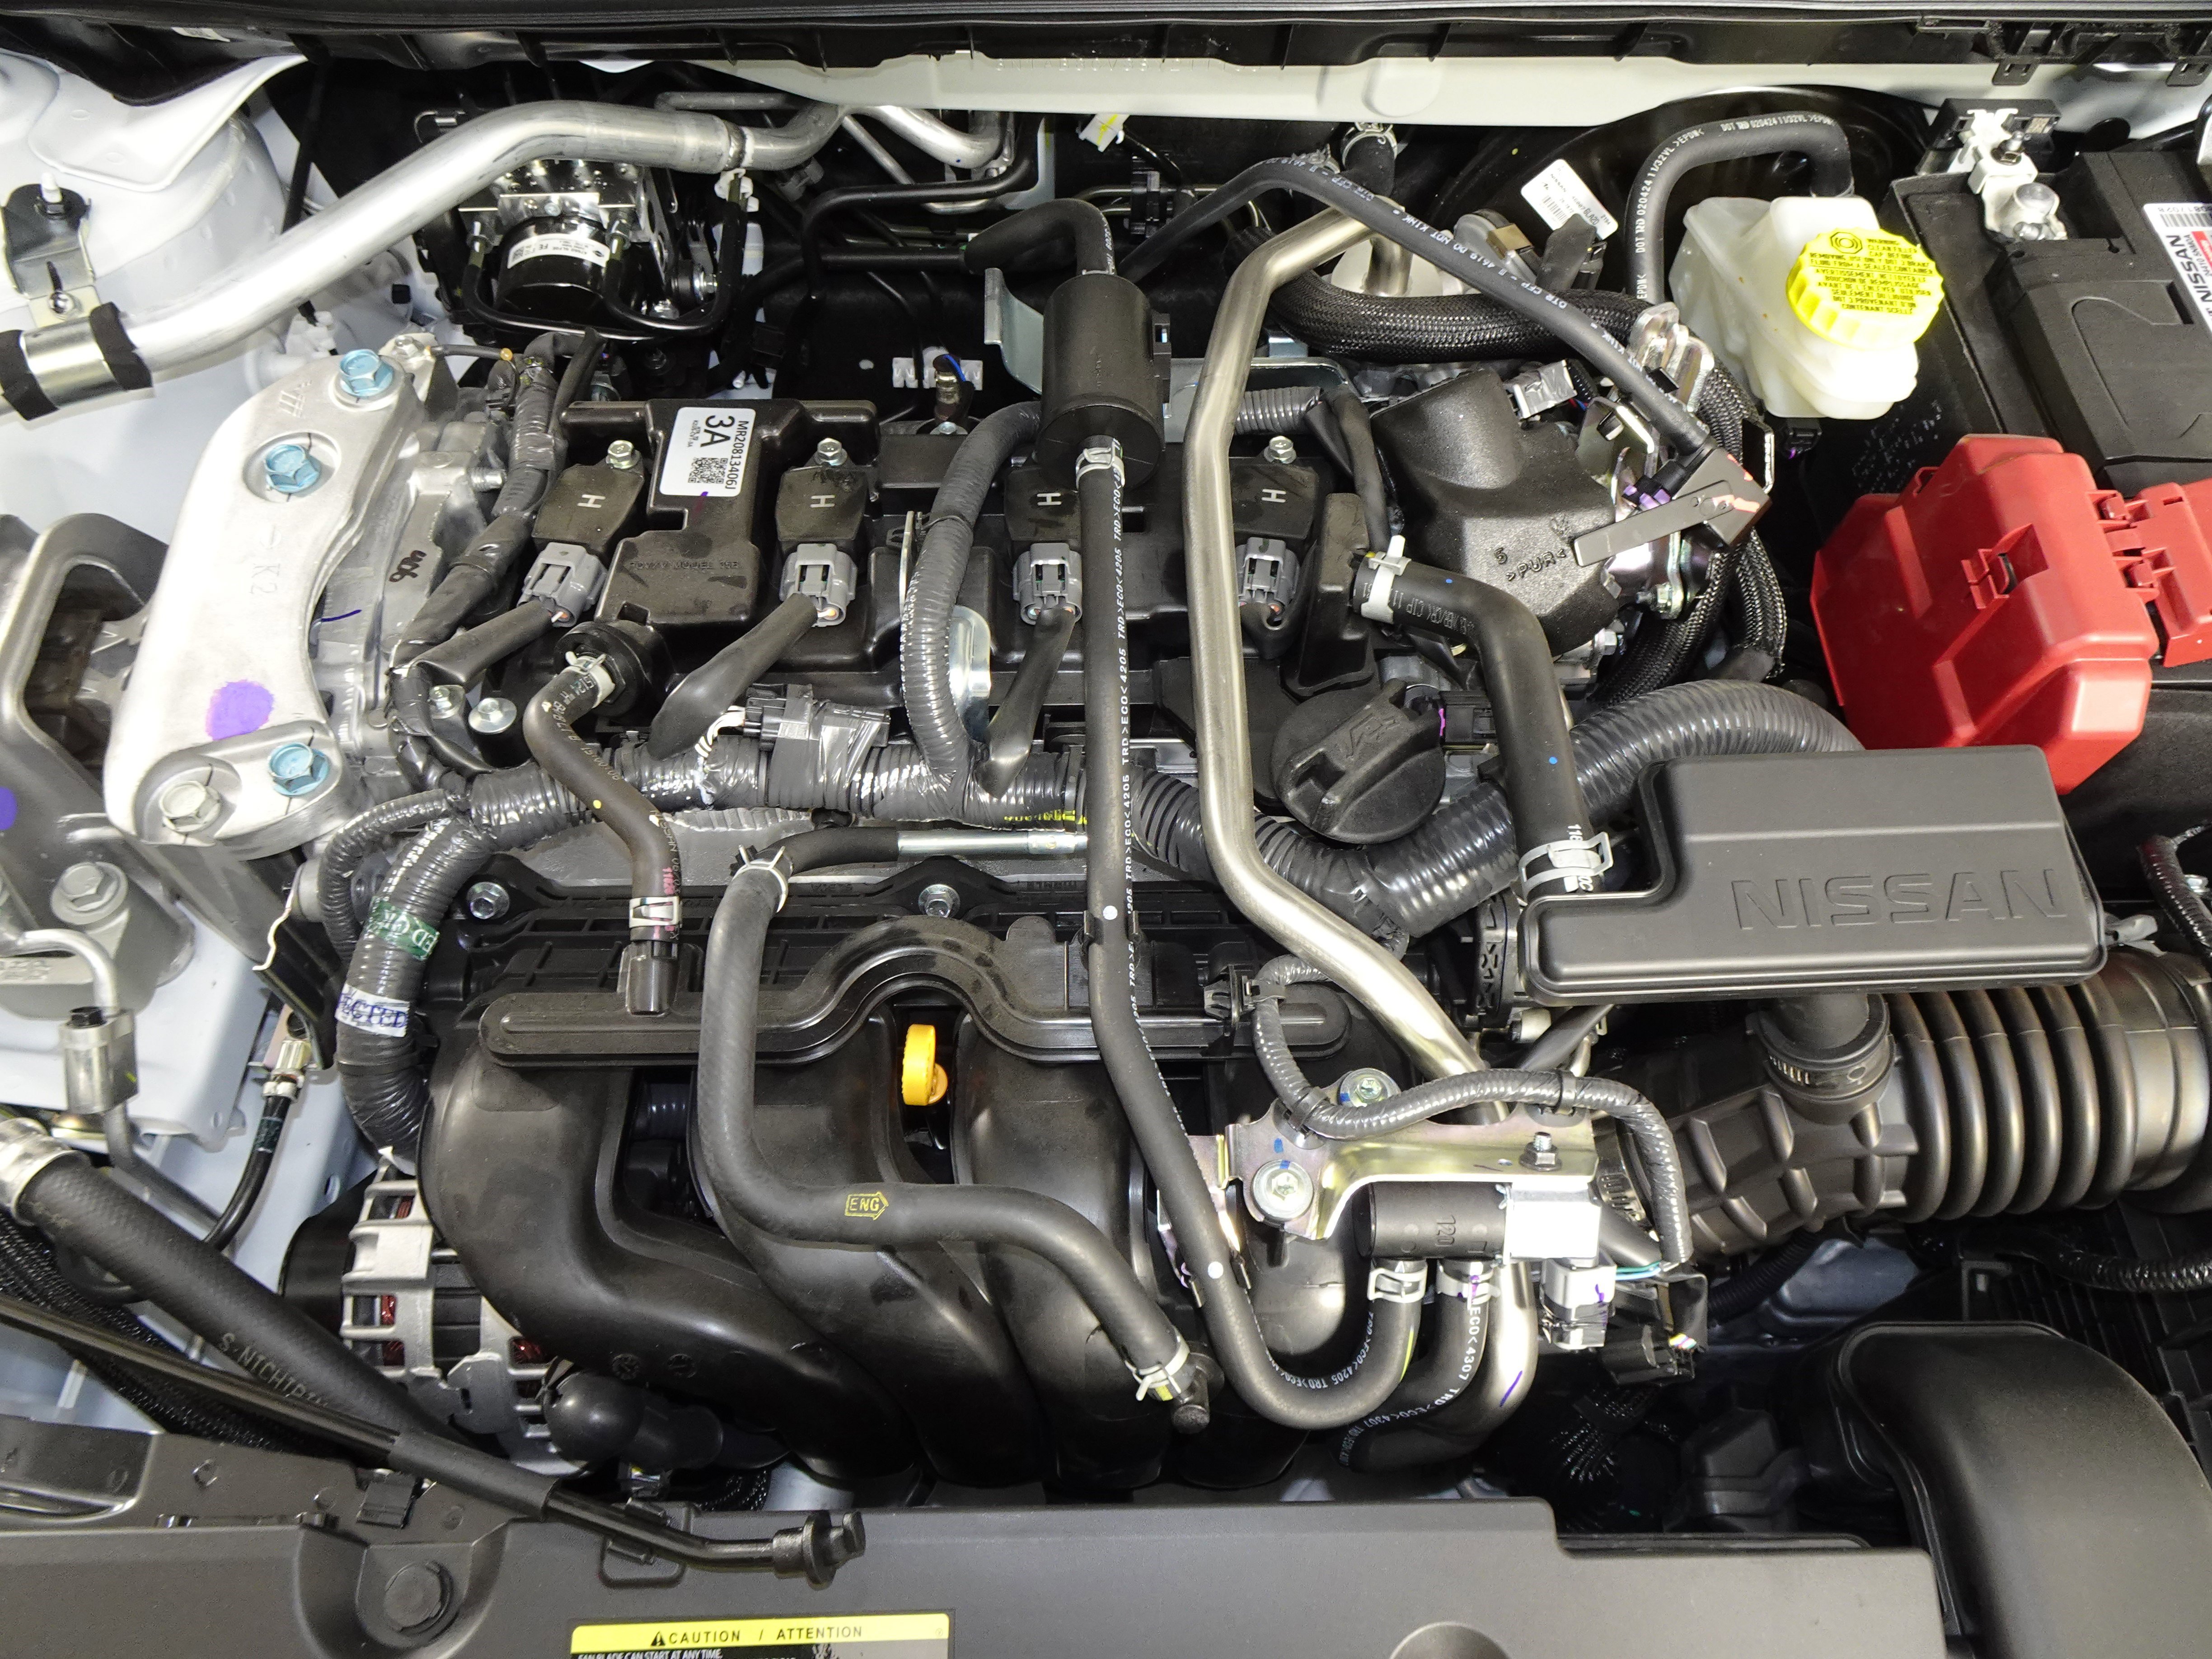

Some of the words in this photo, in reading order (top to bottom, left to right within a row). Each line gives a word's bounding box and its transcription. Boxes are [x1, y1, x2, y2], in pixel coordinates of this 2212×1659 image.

[1636, 180, 1652, 216] 020424
[1636, 237, 1646, 253] DOT
[700, 415, 736, 447] 3A
[1731, 868, 2068, 931] NISSAN
[849, 1196, 881, 1213] ENG
[669, 1630, 740, 1645] CAUTION
[776, 1626, 863, 1640] ATTENTION
